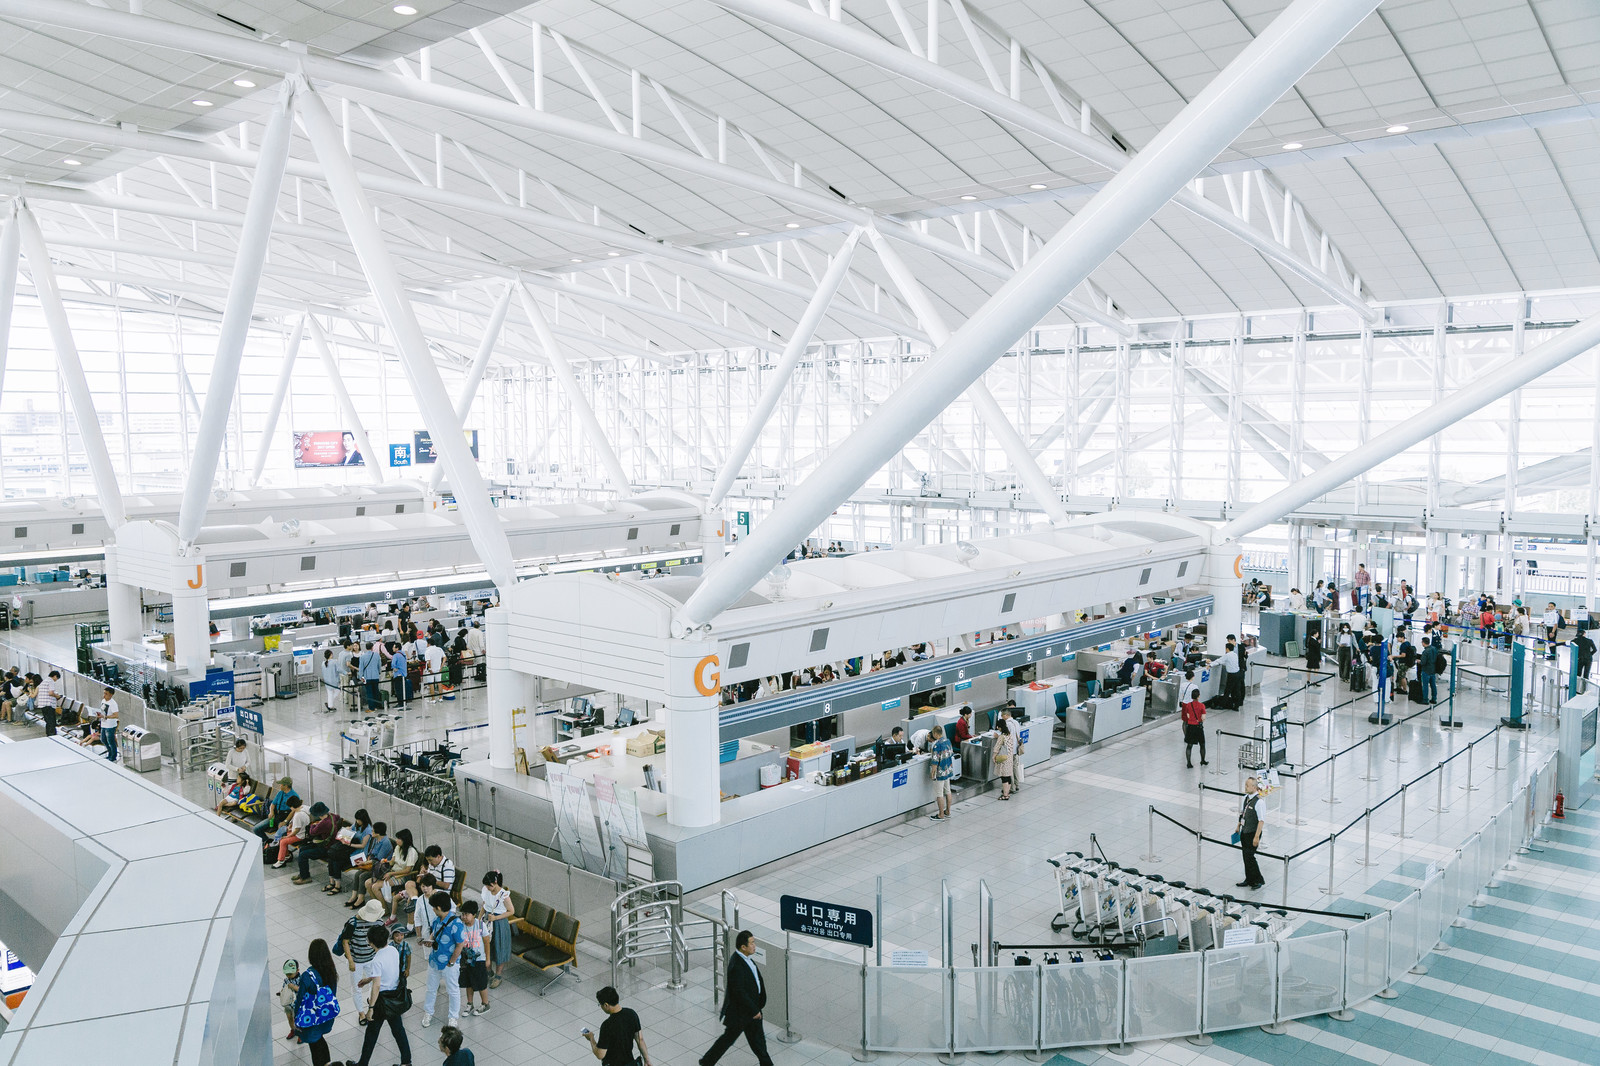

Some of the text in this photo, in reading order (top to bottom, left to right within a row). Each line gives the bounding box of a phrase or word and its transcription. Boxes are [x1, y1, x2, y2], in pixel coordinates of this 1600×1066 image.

[394, 446, 406, 459] 南
[739, 512, 745, 524] 5
[717, 520, 725, 537] J
[187, 564, 203, 589] J
[303, 601, 312, 609] 10
[1151, 621, 1156, 629] 2
[1120, 629, 1125, 637] 3
[1065, 643, 1070, 652] 4
[1026, 652, 1032, 661] 5
[694, 655, 720, 697] G
[958, 670, 964, 679] 6
[911, 681, 917, 692] 7
[824, 703, 831, 713] 8
[796, 903, 857, 925] 出口専用
[801, 924, 825, 936] 출구전용
[812, 919, 844, 931] No Entry
